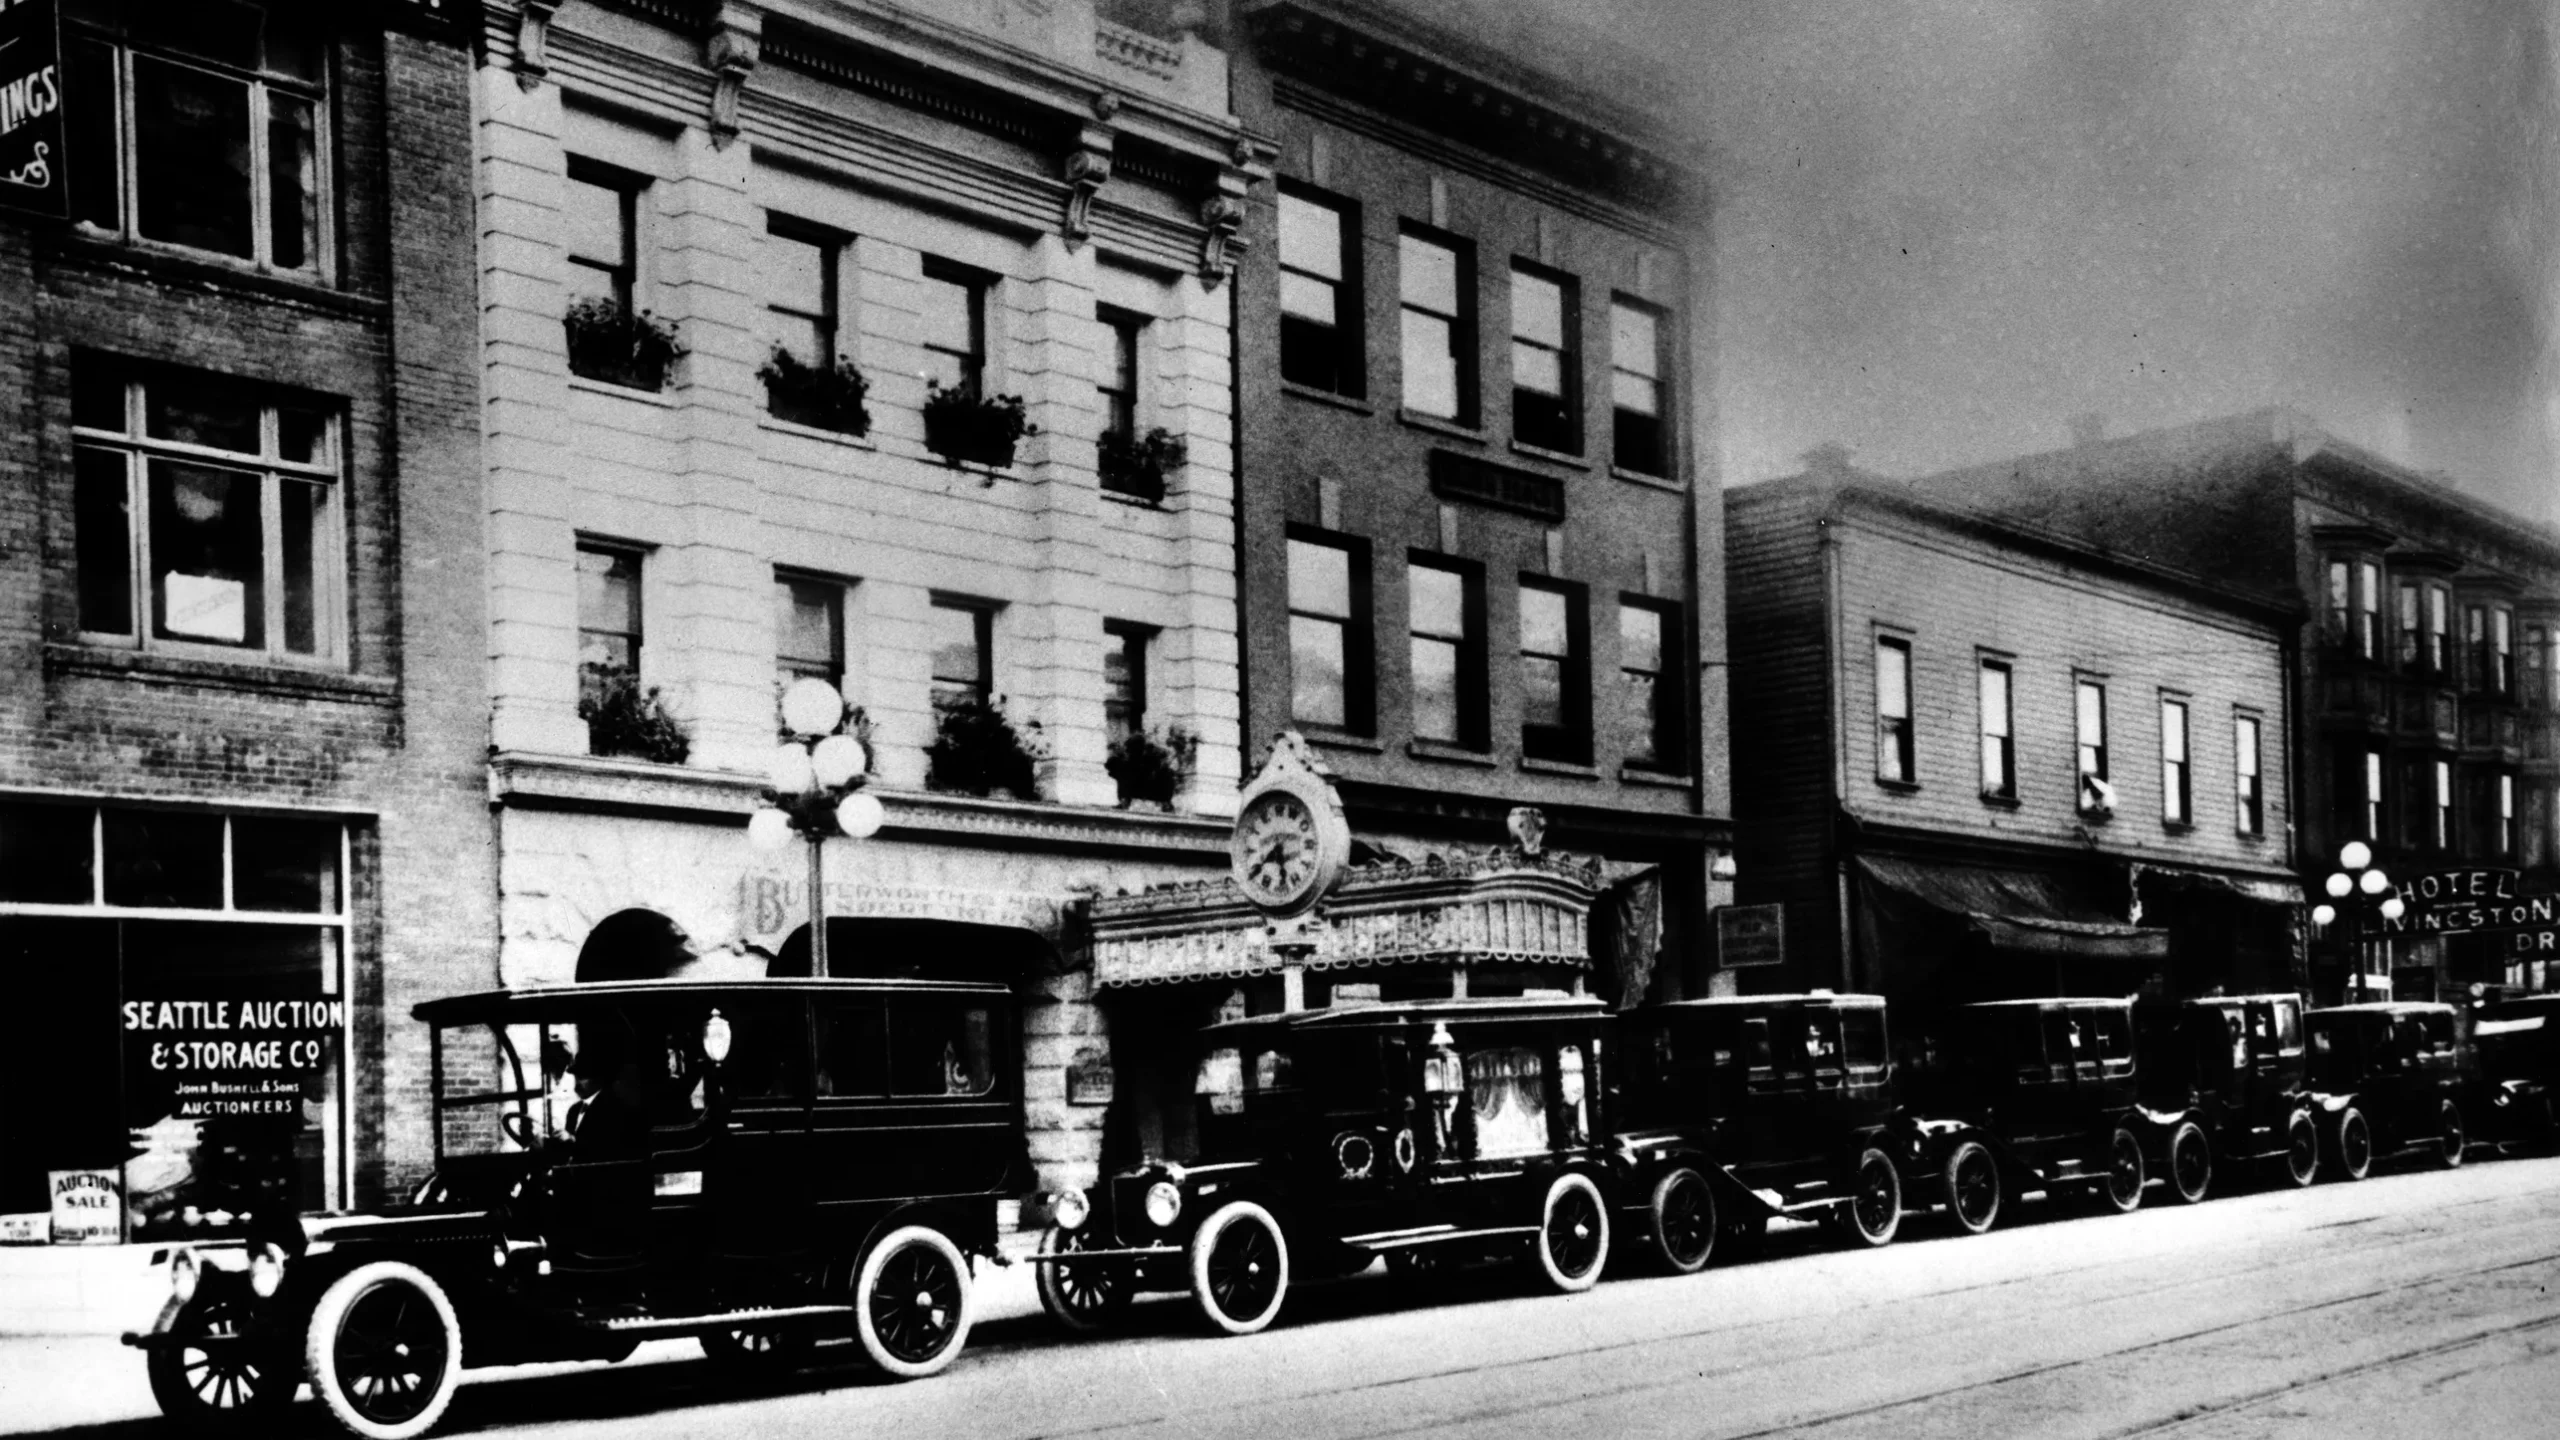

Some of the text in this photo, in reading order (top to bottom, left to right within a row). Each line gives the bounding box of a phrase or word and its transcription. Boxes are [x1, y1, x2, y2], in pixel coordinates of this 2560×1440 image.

[2395, 871, 2514, 903] HOTEL
[2516, 931, 2556, 952] DR
[122, 1001, 343, 1030] SEATTLE AUCTION
[151, 1042, 169, 1070] &
[174, 1041, 282, 1069] STORAGE
[261, 1080, 271, 1093] &
[180, 1100, 293, 1115] AUCTIONEERS
[65, 1195, 110, 1208] SALE
